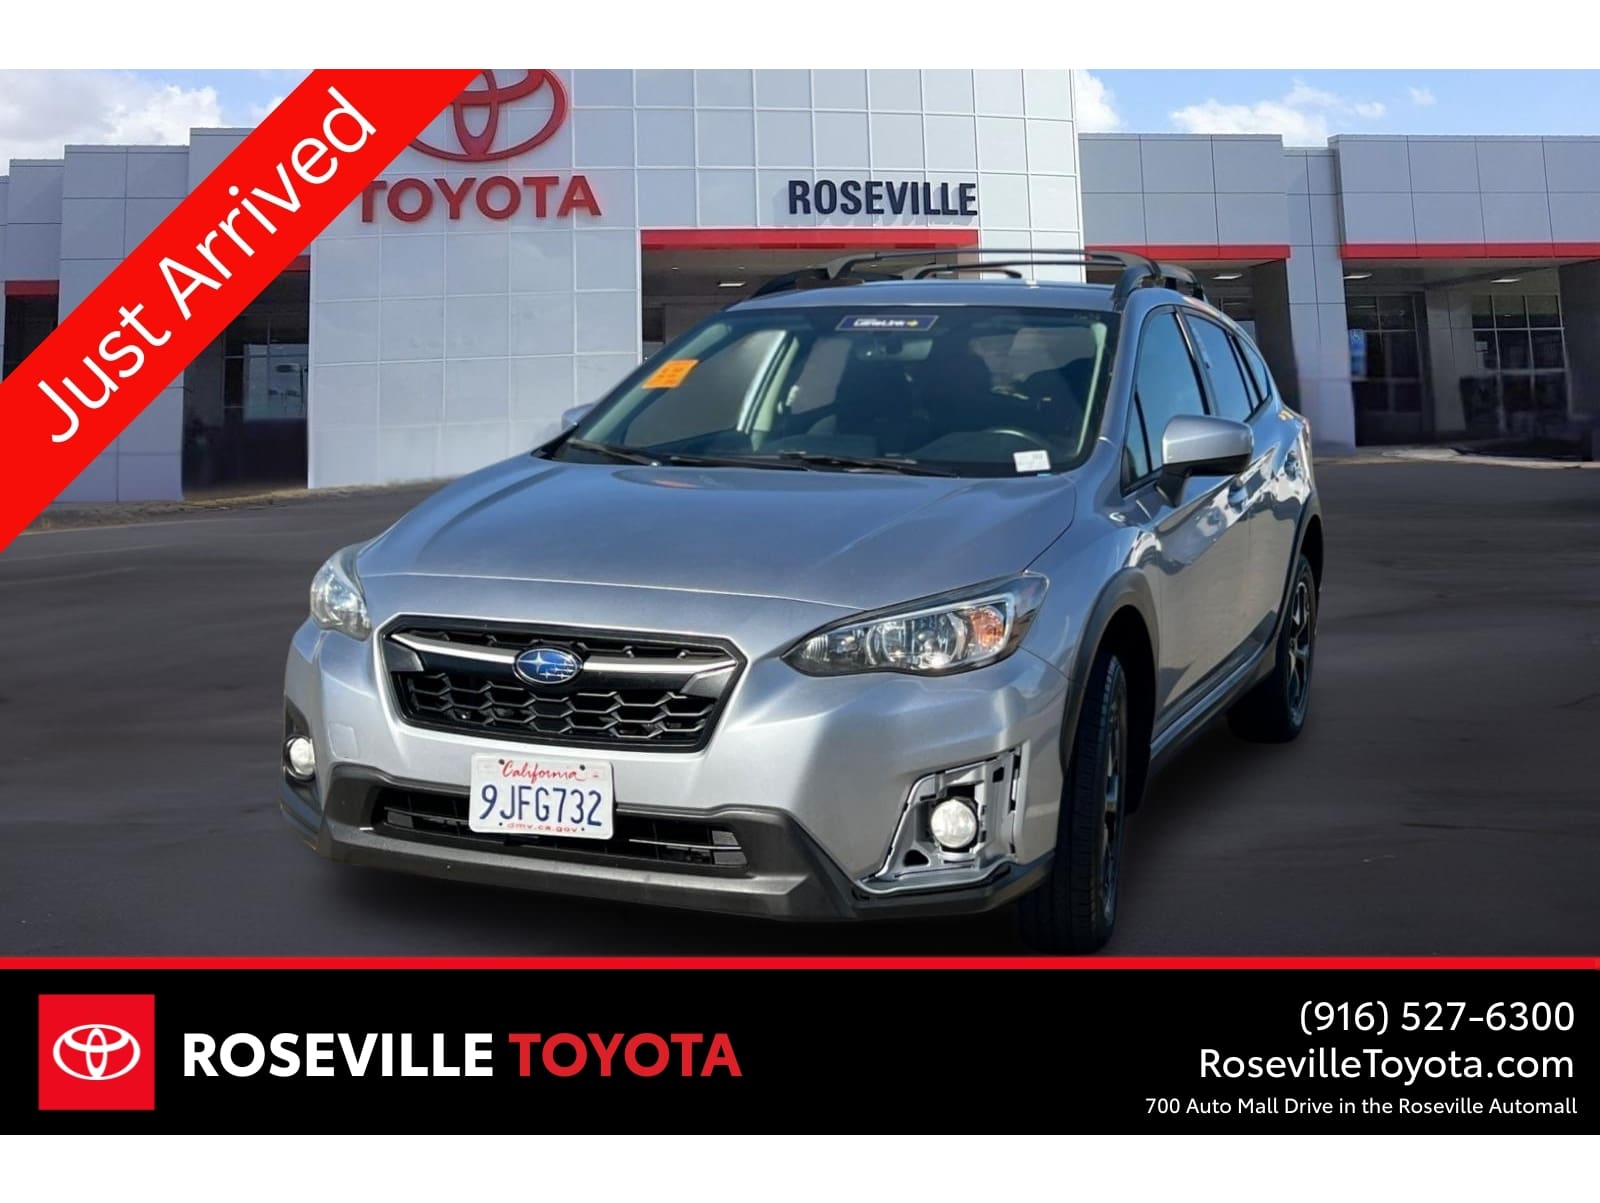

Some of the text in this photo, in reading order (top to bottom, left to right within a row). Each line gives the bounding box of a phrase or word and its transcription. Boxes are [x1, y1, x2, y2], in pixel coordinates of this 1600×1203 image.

[361, 175, 602, 223] TOYOTA
[788, 179, 979, 216] ROSEVILLE
[501, 759, 587, 784] California
[479, 784, 603, 827] 9JFG732
[506, 821, 578, 833] dmv.ca.gov
